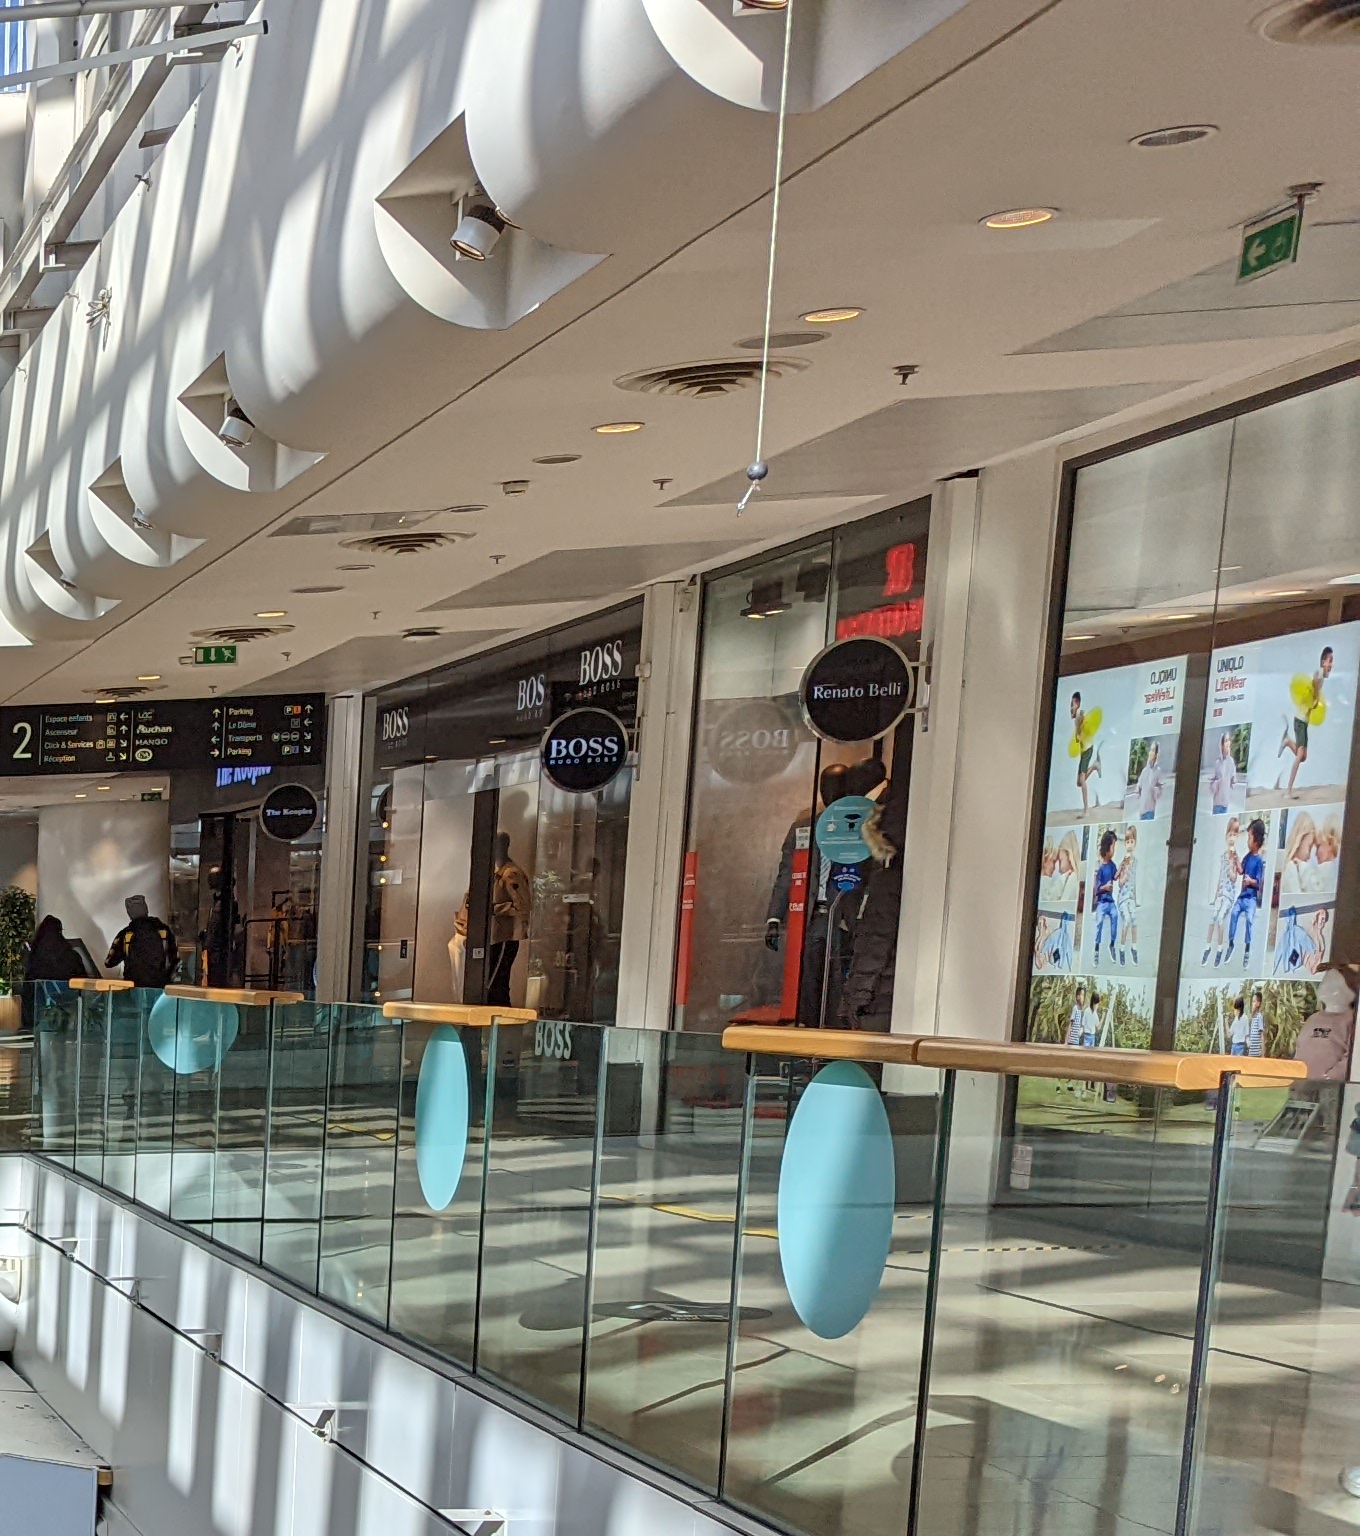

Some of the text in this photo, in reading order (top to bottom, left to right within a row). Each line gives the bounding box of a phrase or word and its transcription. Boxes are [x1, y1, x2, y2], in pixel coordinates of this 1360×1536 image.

[579, 640, 622, 687] BOSS
[1217, 656, 1244, 673] UNIQLO
[813, 682, 902, 701] Renato Belli
[229, 708, 254, 717] Parking
[136, 724, 173, 735] Auchan
[382, 706, 409, 742] BOSS
[12, 721, 32, 760] 2
[135, 738, 168, 747] MANGO
[228, 734, 263, 743] Transports
[227, 748, 253, 758] Parking
[549, 736, 619, 759] BOSS
[587, 756, 617, 764] BOSS
